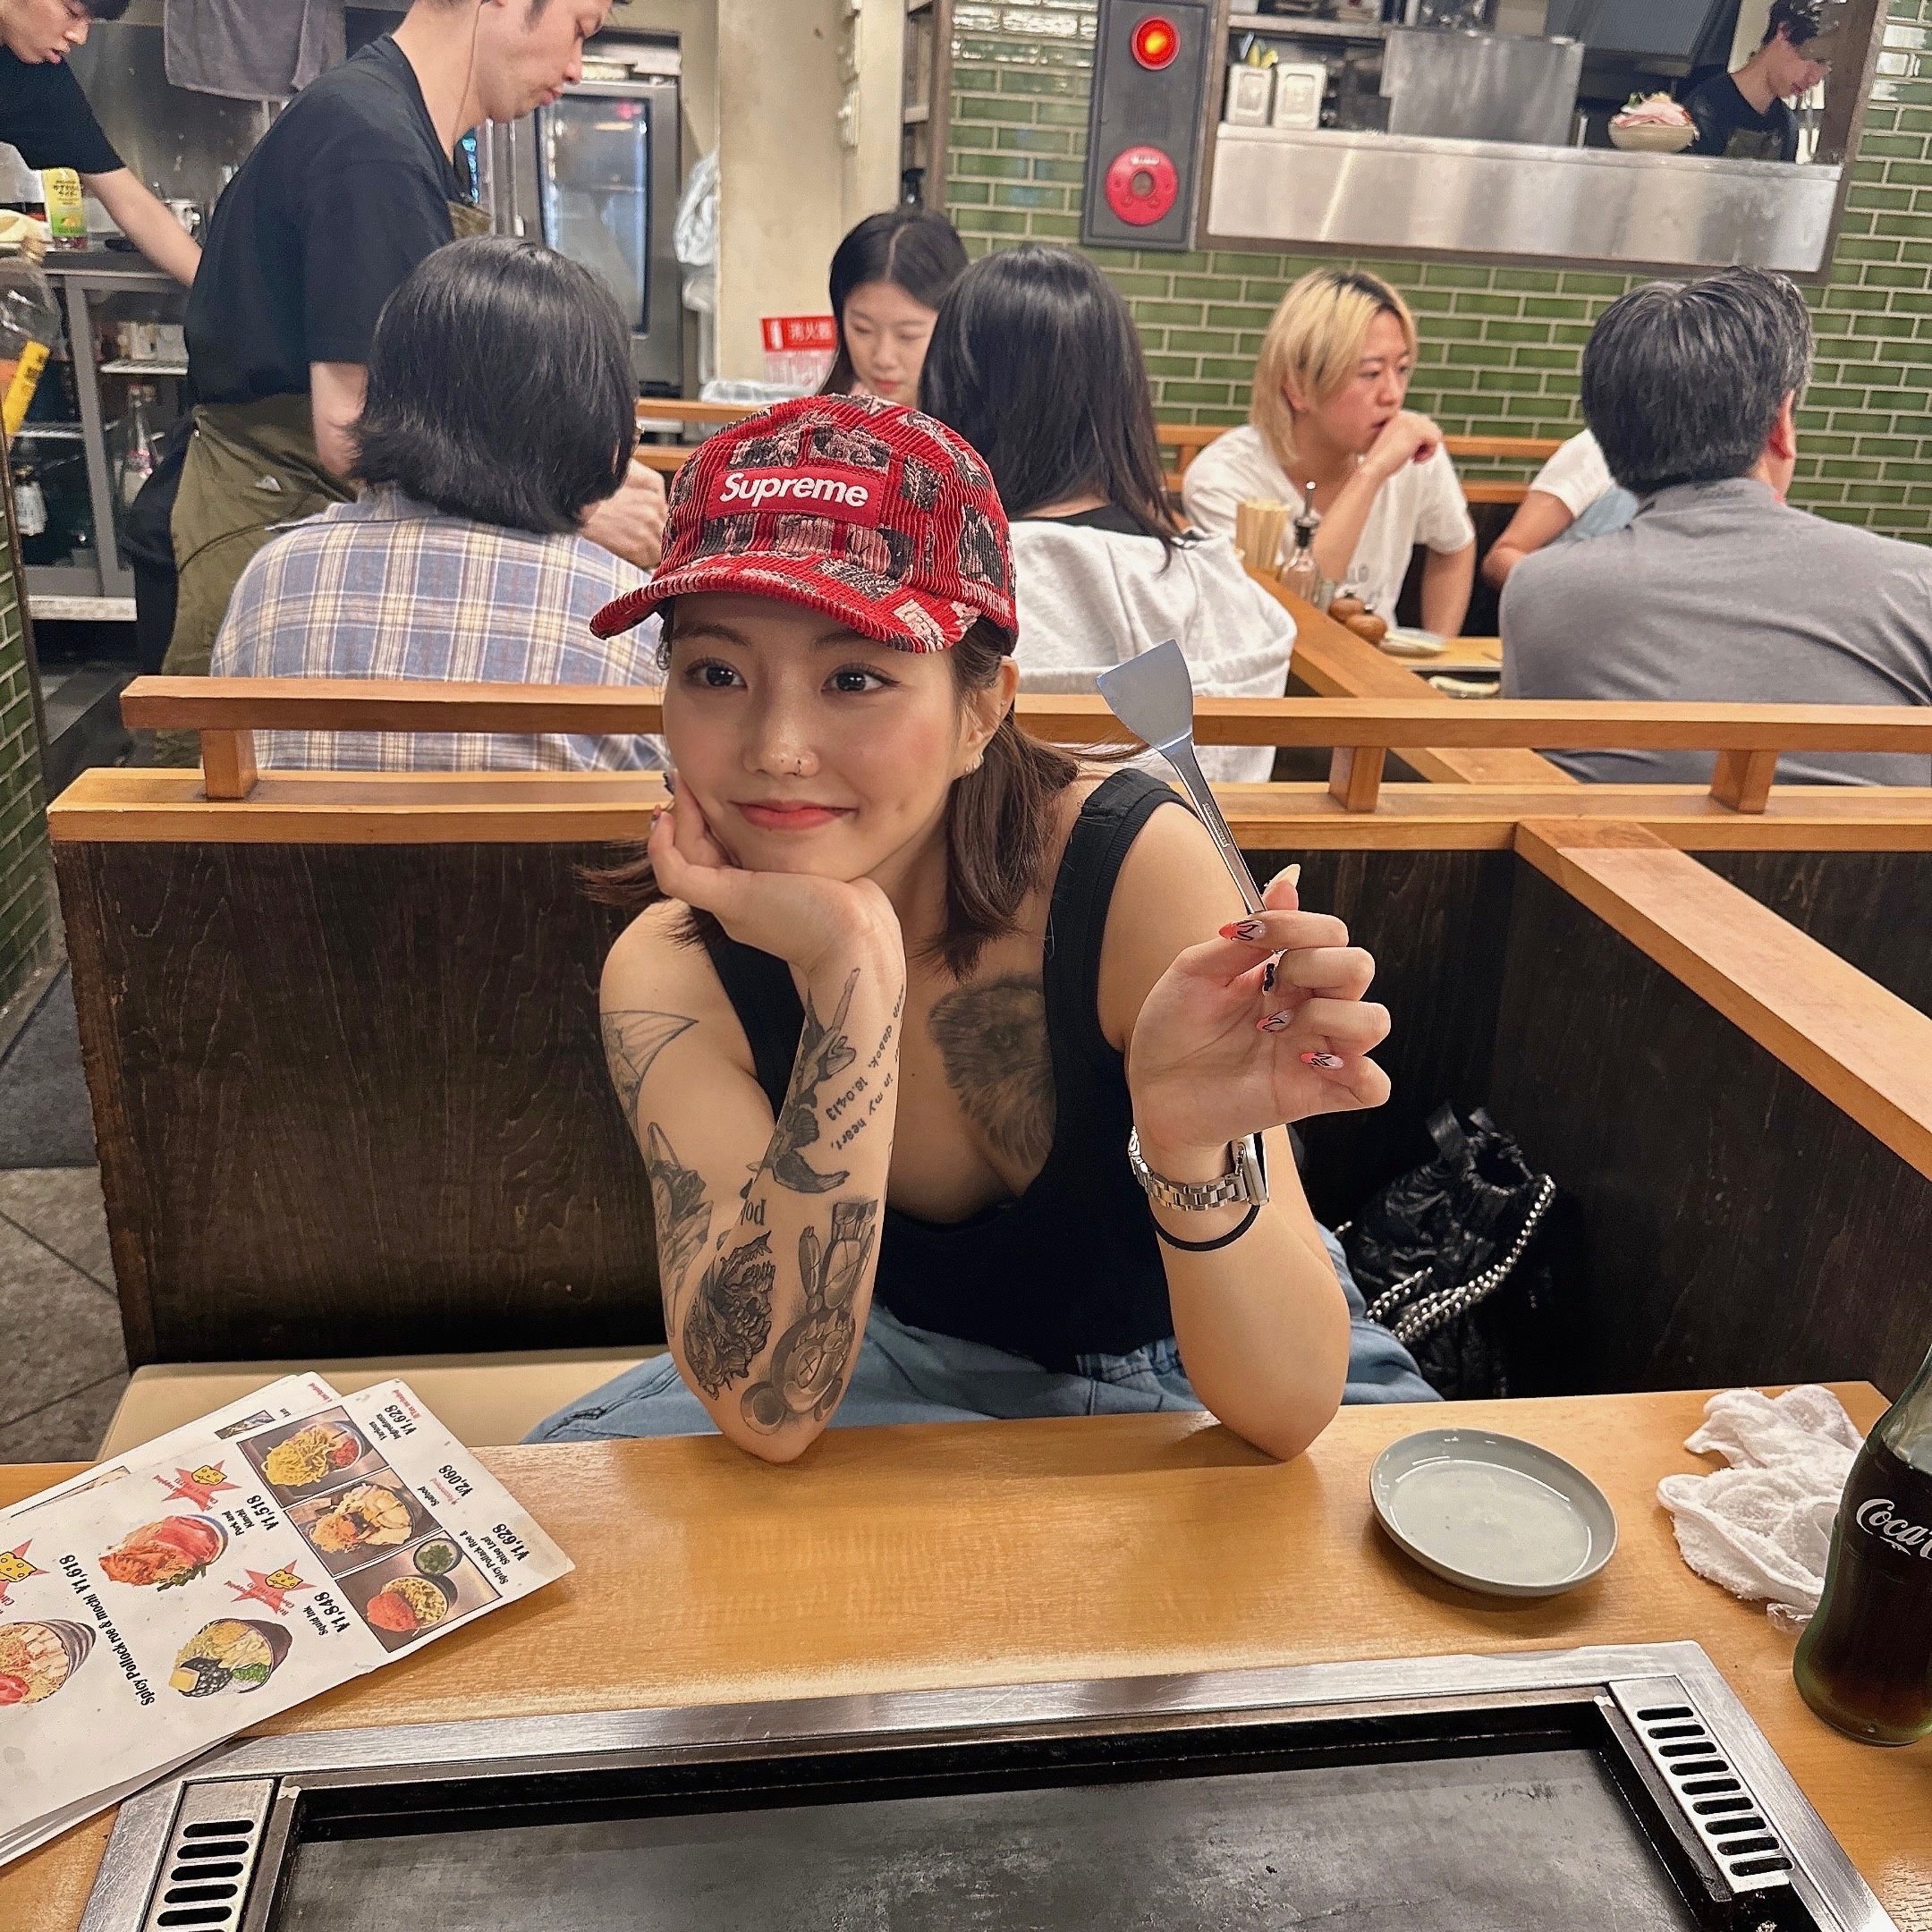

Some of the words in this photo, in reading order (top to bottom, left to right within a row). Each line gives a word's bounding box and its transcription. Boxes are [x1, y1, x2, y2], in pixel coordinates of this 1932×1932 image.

[719, 472, 869, 508] Supreme
[869, 1092, 883, 1115] my
[385, 1405, 417, 1435] ¥1,628
[438, 1465, 473, 1497] ¥2,068
[417, 1487, 440, 1506] Seafood
[222, 1511, 234, 1521] and
[247, 1496, 279, 1530] ¥1,518
[465, 1536, 478, 1547] Roe
[480, 1537, 496, 1549] Leaf
[492, 1523, 530, 1561] ¥1,628
[494, 1548, 510, 1564] Shiso
[59, 1555, 90, 1594] ¥1,618
[492, 1567, 508, 1584] Spicy
[83, 1594, 108, 1621] mochi
[303, 1606, 316, 1618] Ink
[314, 1592, 351, 1632] ¥1,848
[98, 1620, 113, 1629] &
[106, 1628, 122, 1643] roe
[309, 1617, 328, 1635] Squid
[113, 1642, 140, 1680] Pollock
[133, 1679, 155, 1706] Spicy
